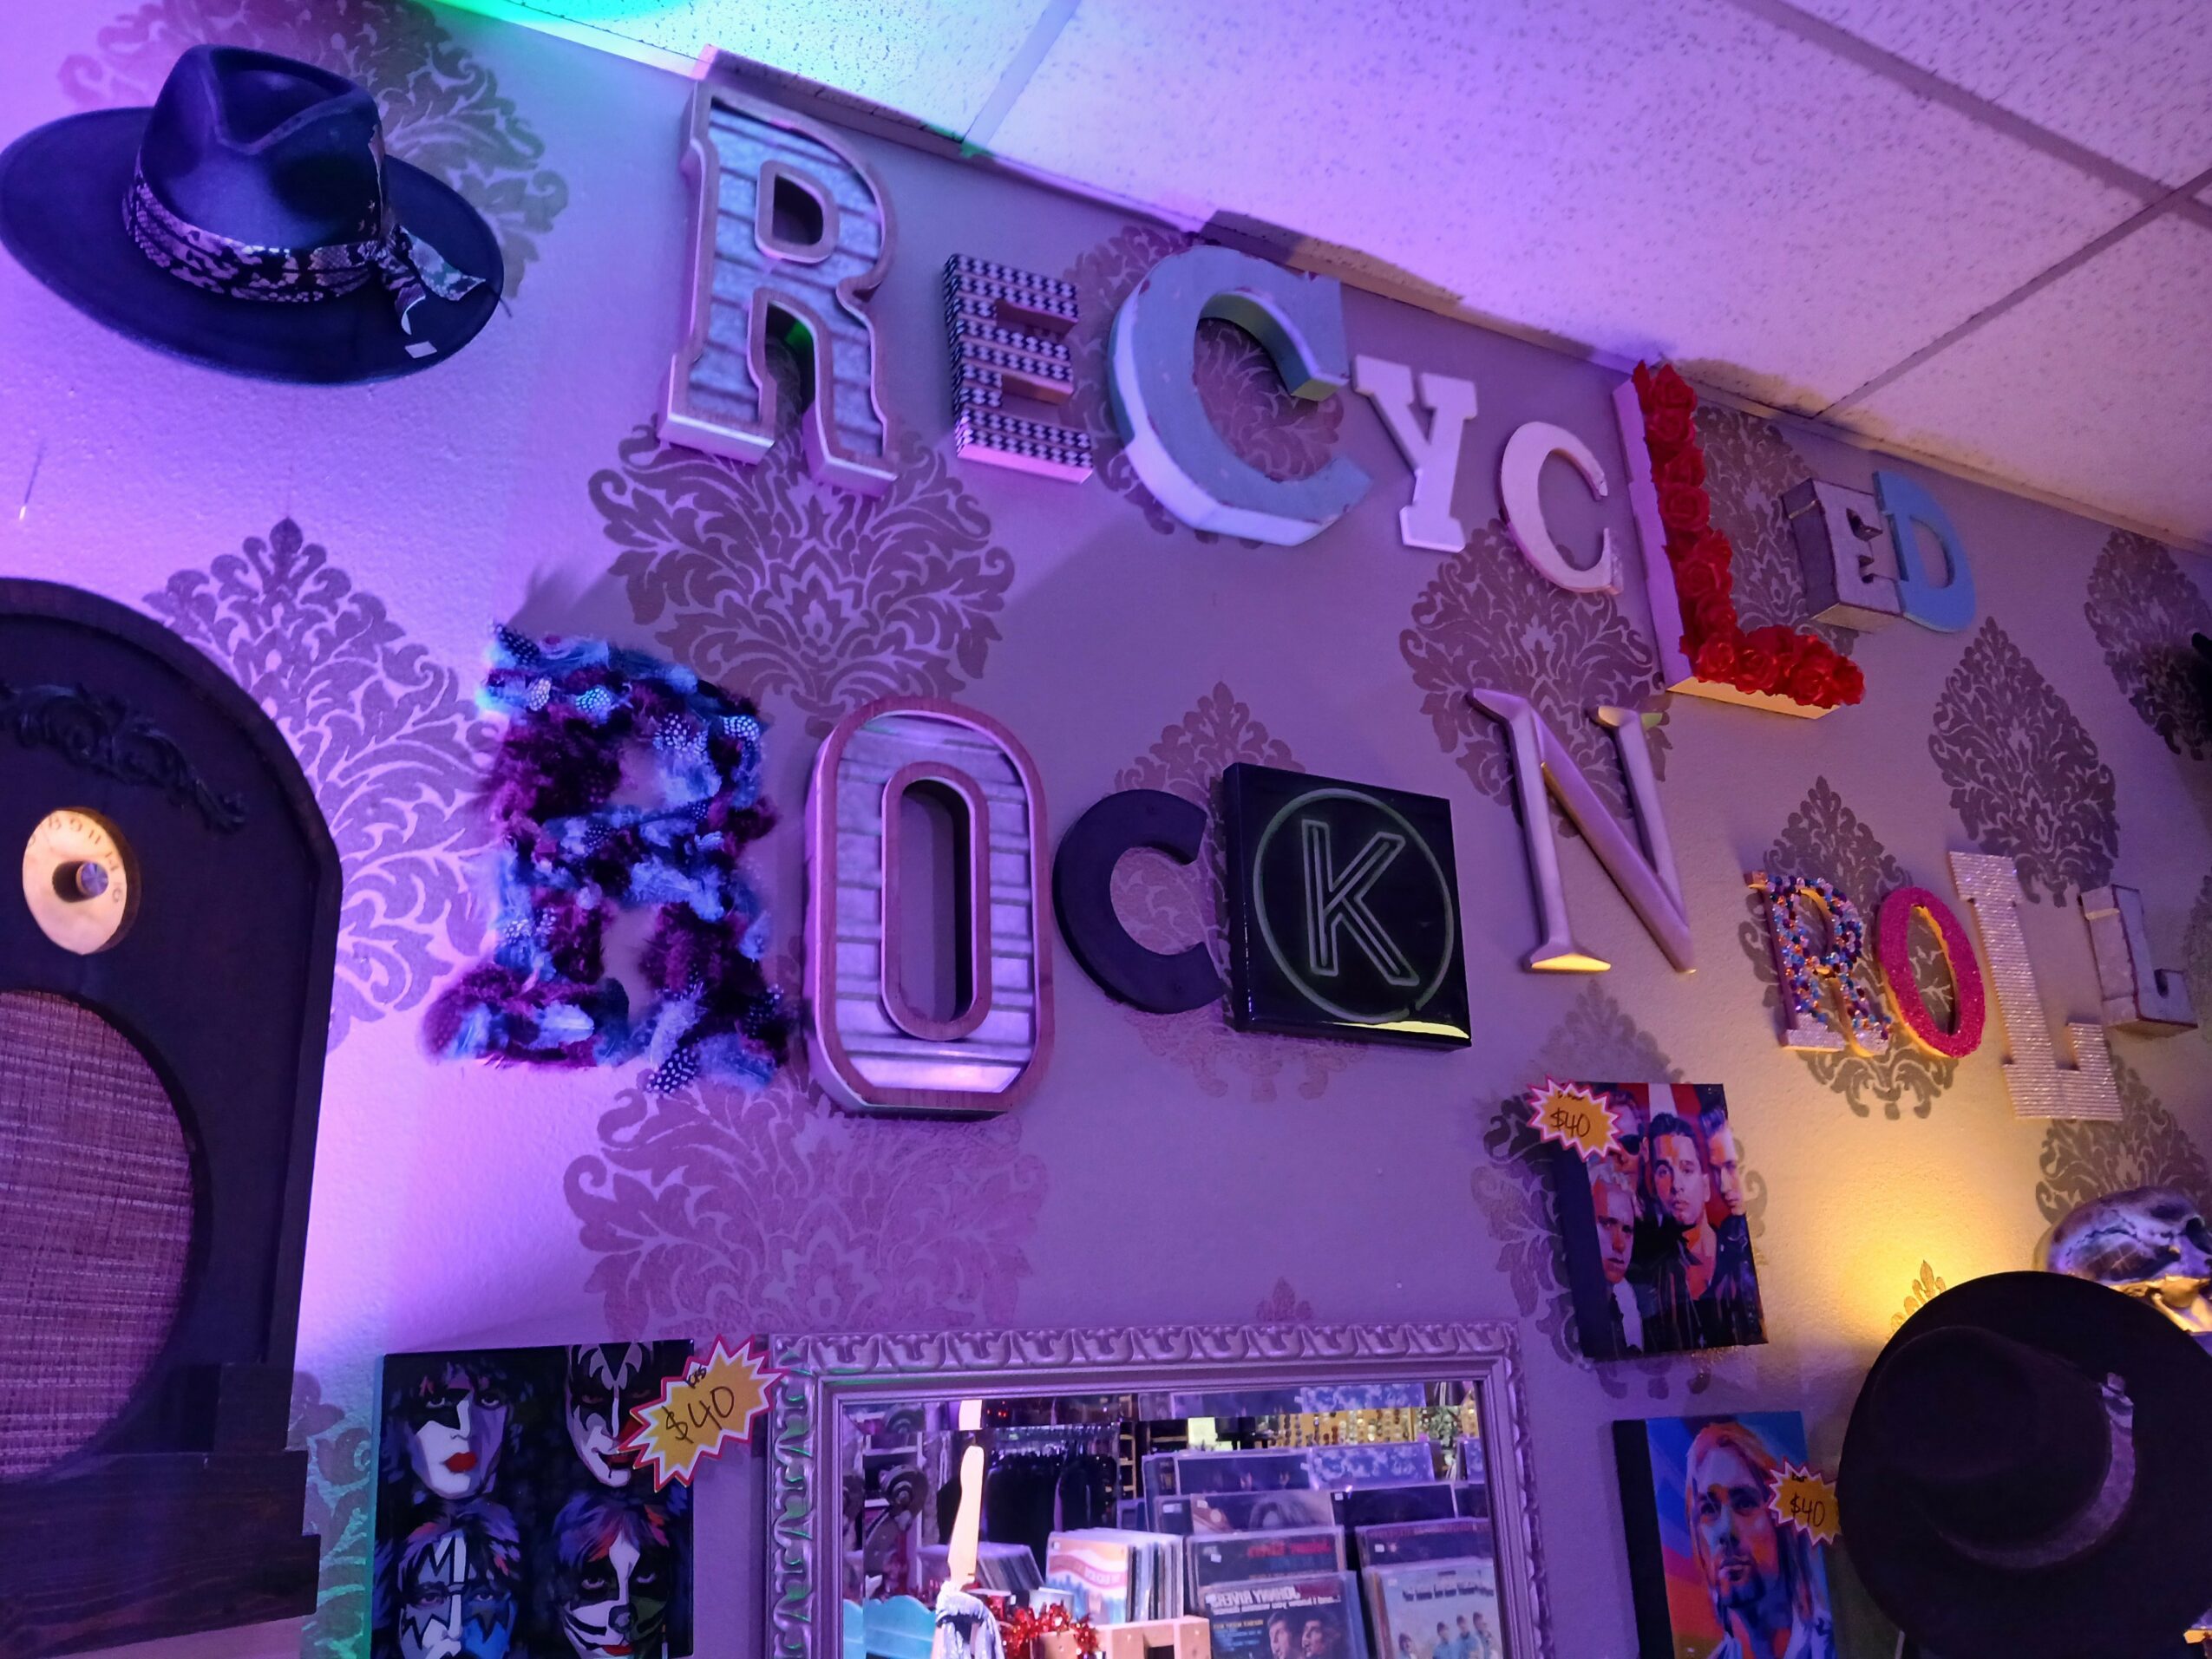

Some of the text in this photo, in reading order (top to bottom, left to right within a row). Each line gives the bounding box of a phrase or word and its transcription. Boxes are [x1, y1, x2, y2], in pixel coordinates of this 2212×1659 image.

[658, 80, 1977, 719] RECYCLED
[423, 621, 2198, 1121] ROCK N ROLL
[1550, 1107, 1591, 1138] $40
[661, 1386, 735, 1444] $40
[1790, 1491, 1826, 1527] $40
